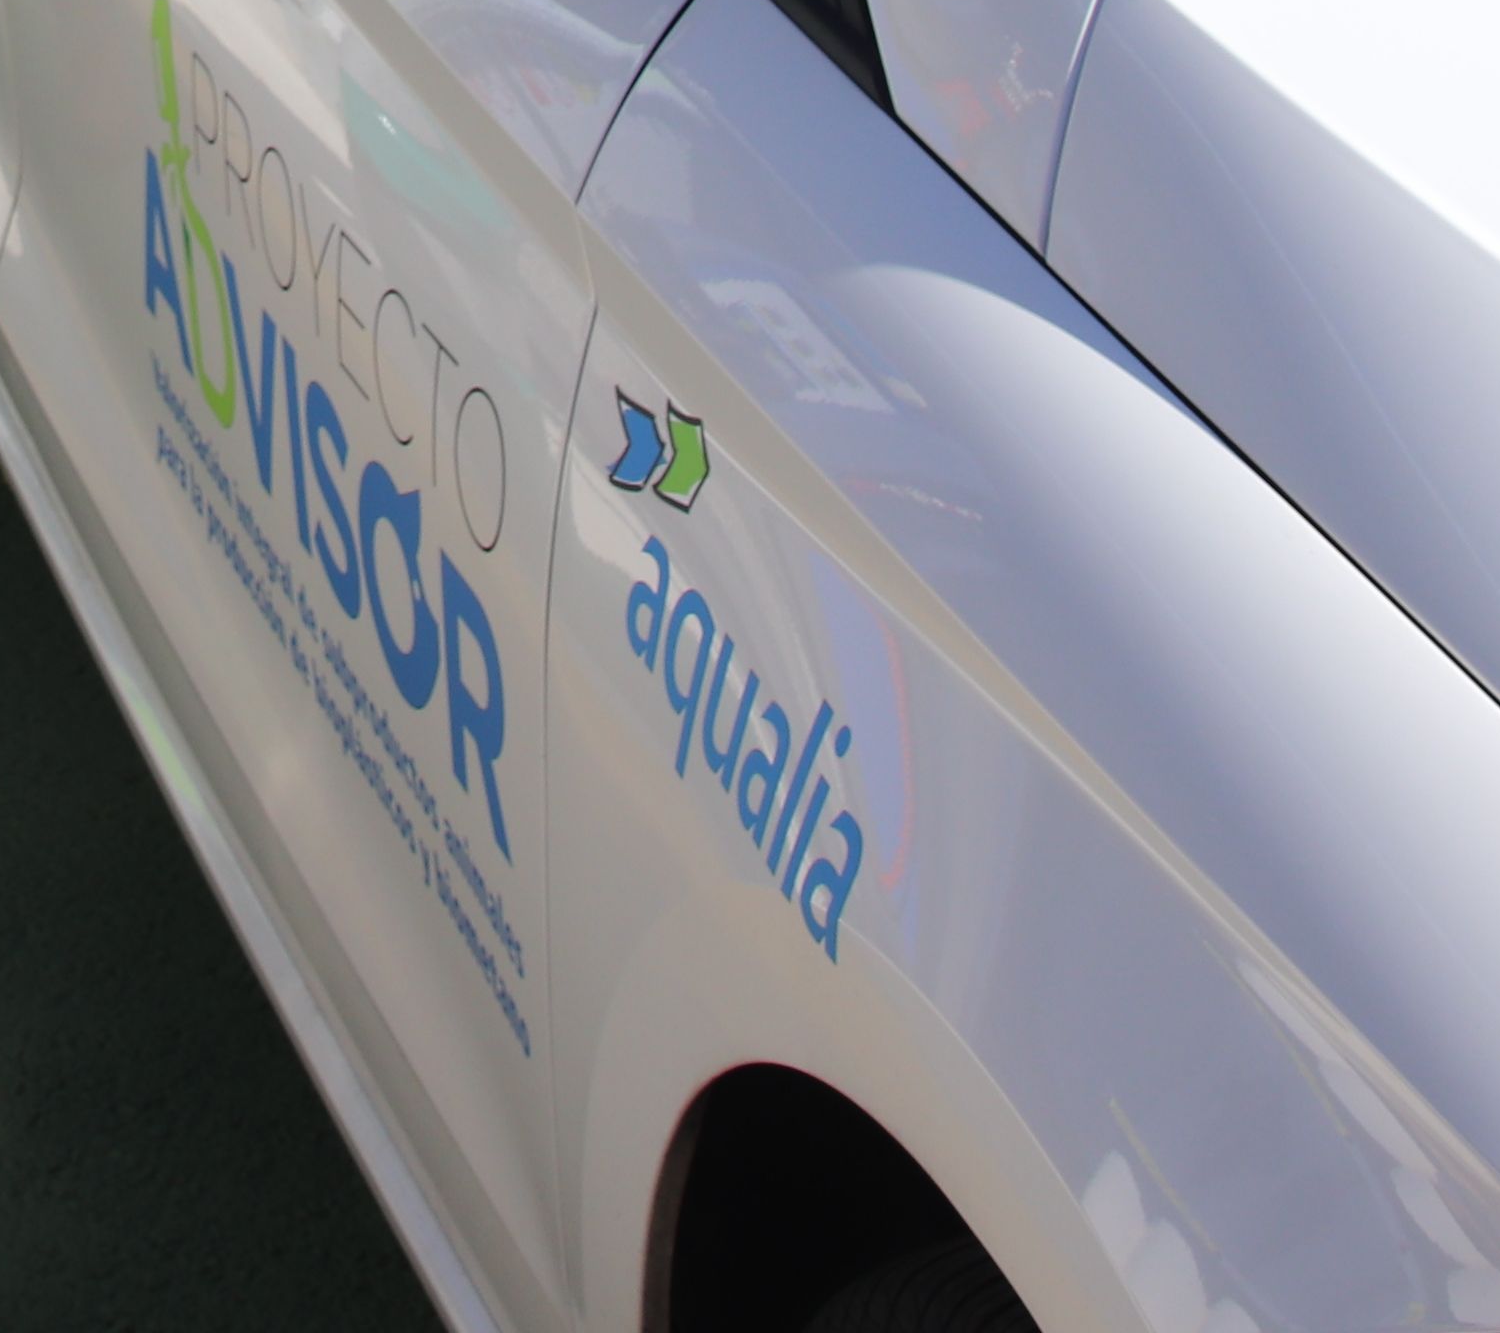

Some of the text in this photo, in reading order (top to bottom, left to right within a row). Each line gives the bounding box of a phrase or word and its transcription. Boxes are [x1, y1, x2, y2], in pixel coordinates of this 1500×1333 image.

[145, 146, 513, 867] ADVISOR
[191, 51, 507, 554] PROYECTO
[157, 423, 189, 492] para
[190, 460, 205, 517] la
[290, 628, 311, 687] de
[419, 838, 431, 887] y
[433, 849, 532, 1059] biometano
[234, 480, 296, 605] integral
[297, 584, 320, 645] de
[321, 627, 441, 832] subproductos
[444, 817, 526, 980] animales
[626, 535, 863, 966] aqualia
